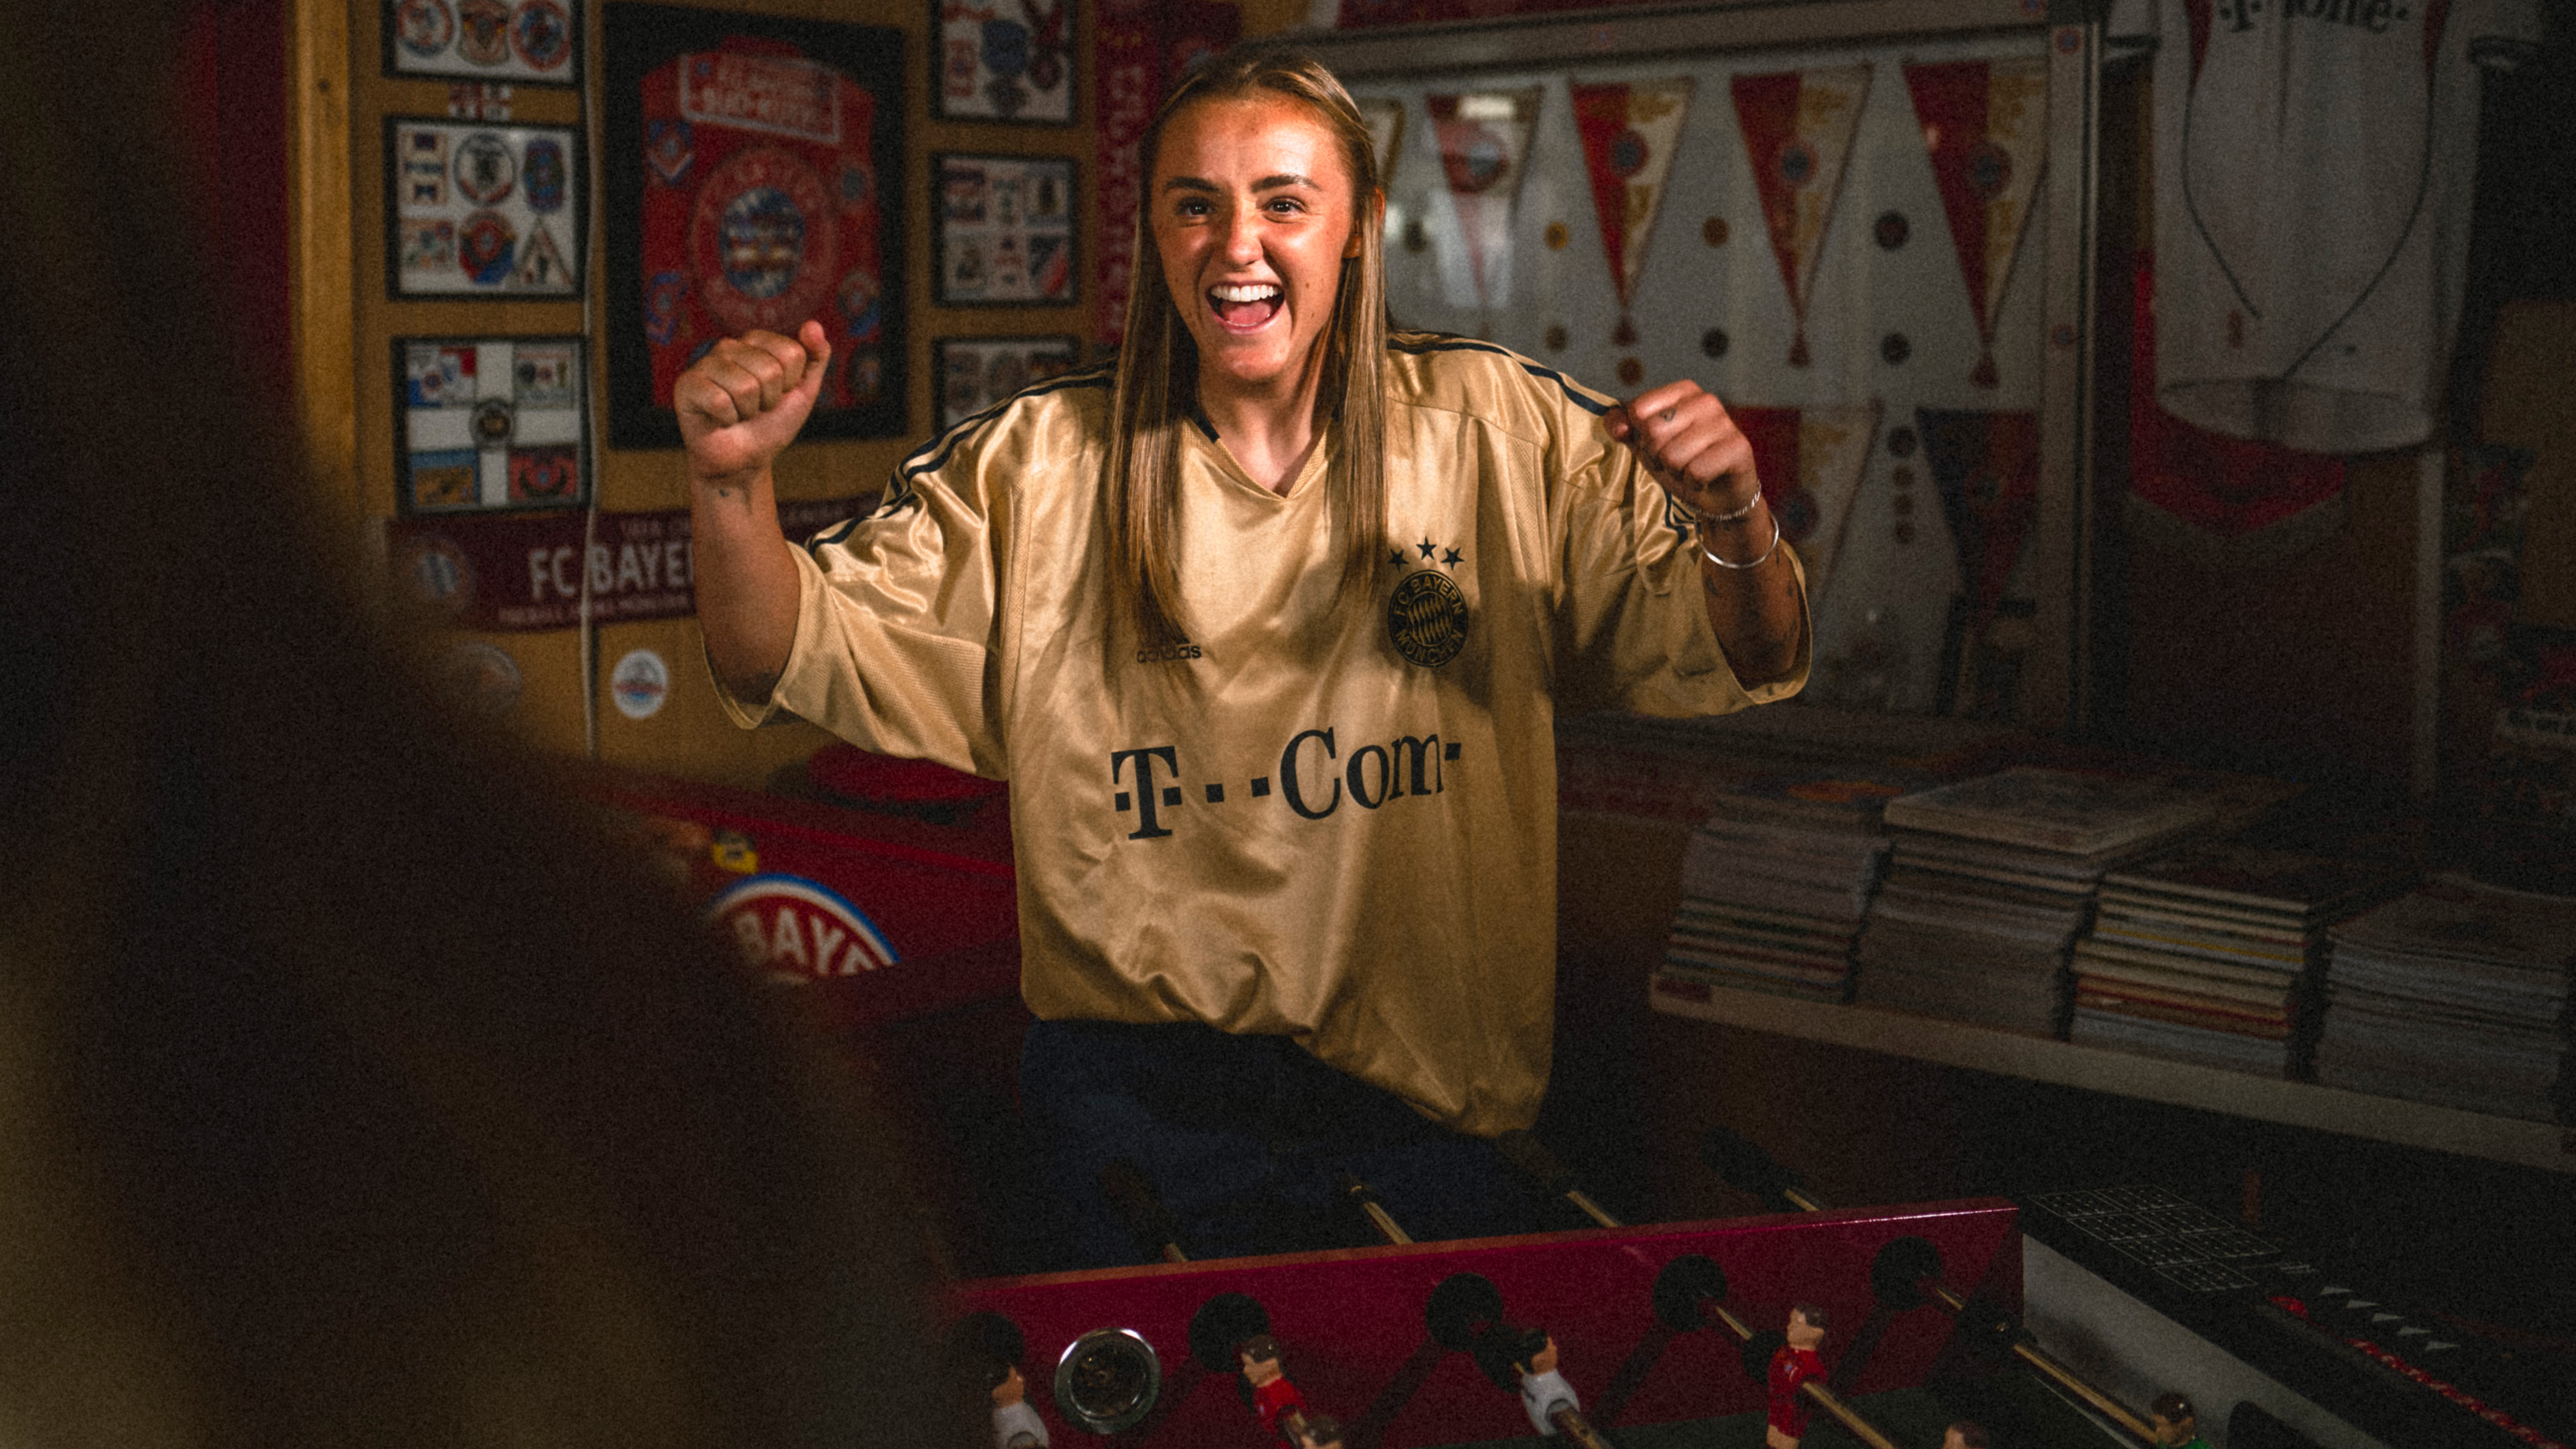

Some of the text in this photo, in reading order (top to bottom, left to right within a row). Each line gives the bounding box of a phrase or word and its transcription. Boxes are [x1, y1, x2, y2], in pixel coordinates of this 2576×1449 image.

[529, 548, 576, 601] FC
[1393, 576, 1464, 616] FC BAYERN
